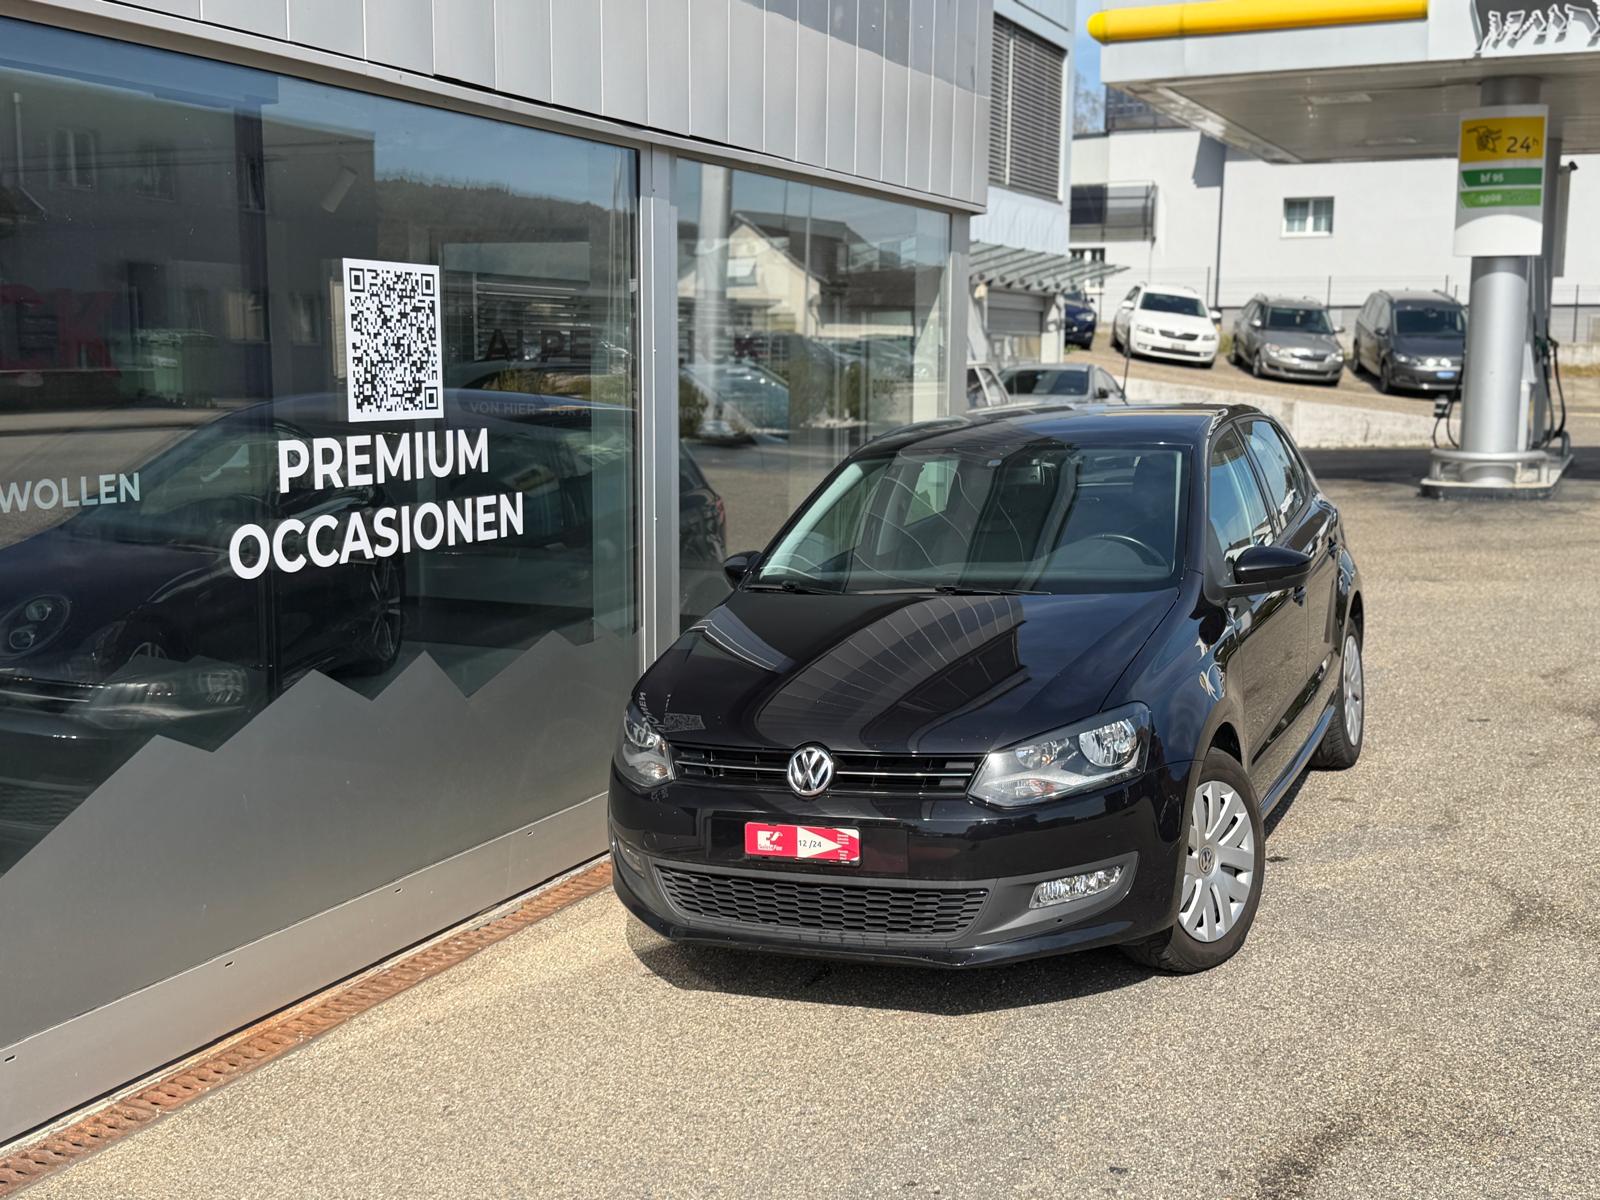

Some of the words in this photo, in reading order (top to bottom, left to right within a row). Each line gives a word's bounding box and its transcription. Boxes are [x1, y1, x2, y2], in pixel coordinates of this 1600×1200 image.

[470, 401, 499, 415] VON
[504, 402, 537, 416] HIER
[277, 427, 490, 494] PREMIUM
[0, 471, 141, 514] WOLLEN
[228, 491, 525, 581] OCCASIONEN
